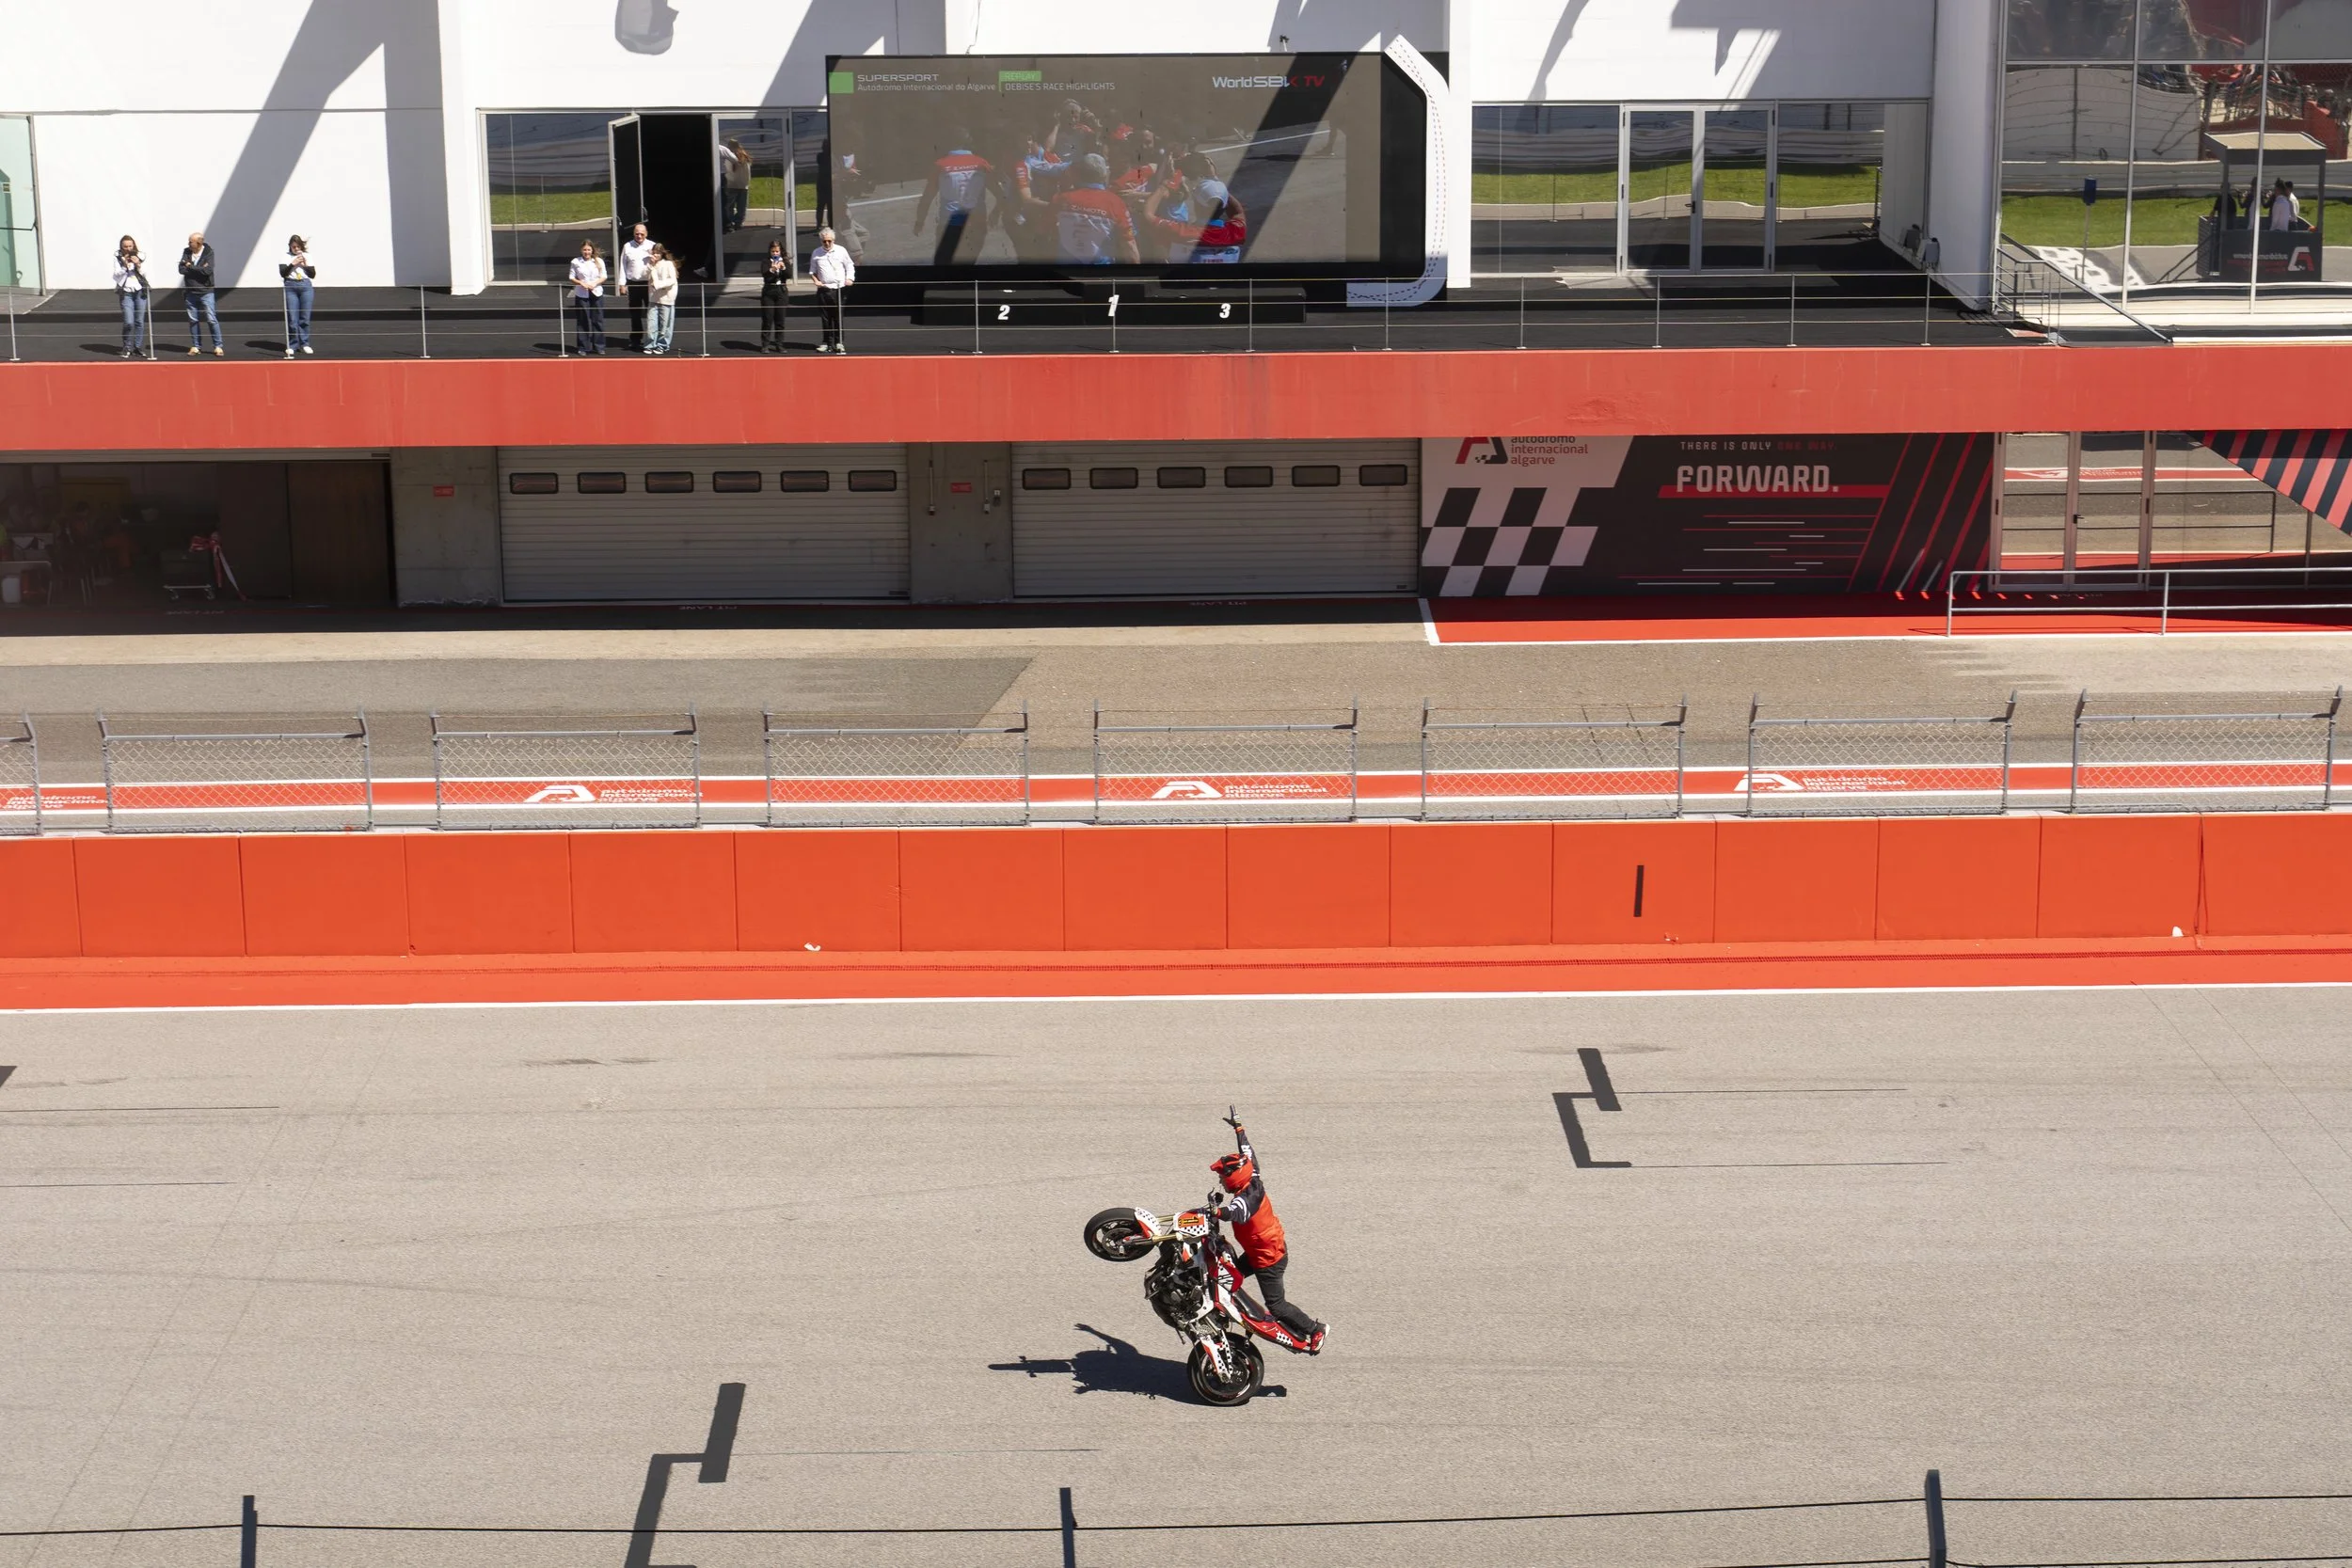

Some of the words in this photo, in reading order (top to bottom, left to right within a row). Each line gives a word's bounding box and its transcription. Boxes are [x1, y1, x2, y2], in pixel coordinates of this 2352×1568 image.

[857, 73, 939, 82] SUPERSPORT
[1212, 75, 1298, 88] WorldSBK
[1304, 75, 1326, 87] TV
[967, 83, 995, 92] Algarve
[1107, 294, 1120, 317] 1
[1219, 303, 1232, 319] 3
[998, 305, 1010, 320] 2
[1511, 444, 1588, 454] internacional
[1680, 441, 1717, 451] THERE
[1724, 441, 1735, 451] IS
[1741, 441, 1772, 451] ONLY
[1777, 441, 1804, 451] ONE
[1511, 455, 1555, 467] algarve
[1677, 465, 1839, 493] FORWARD.
